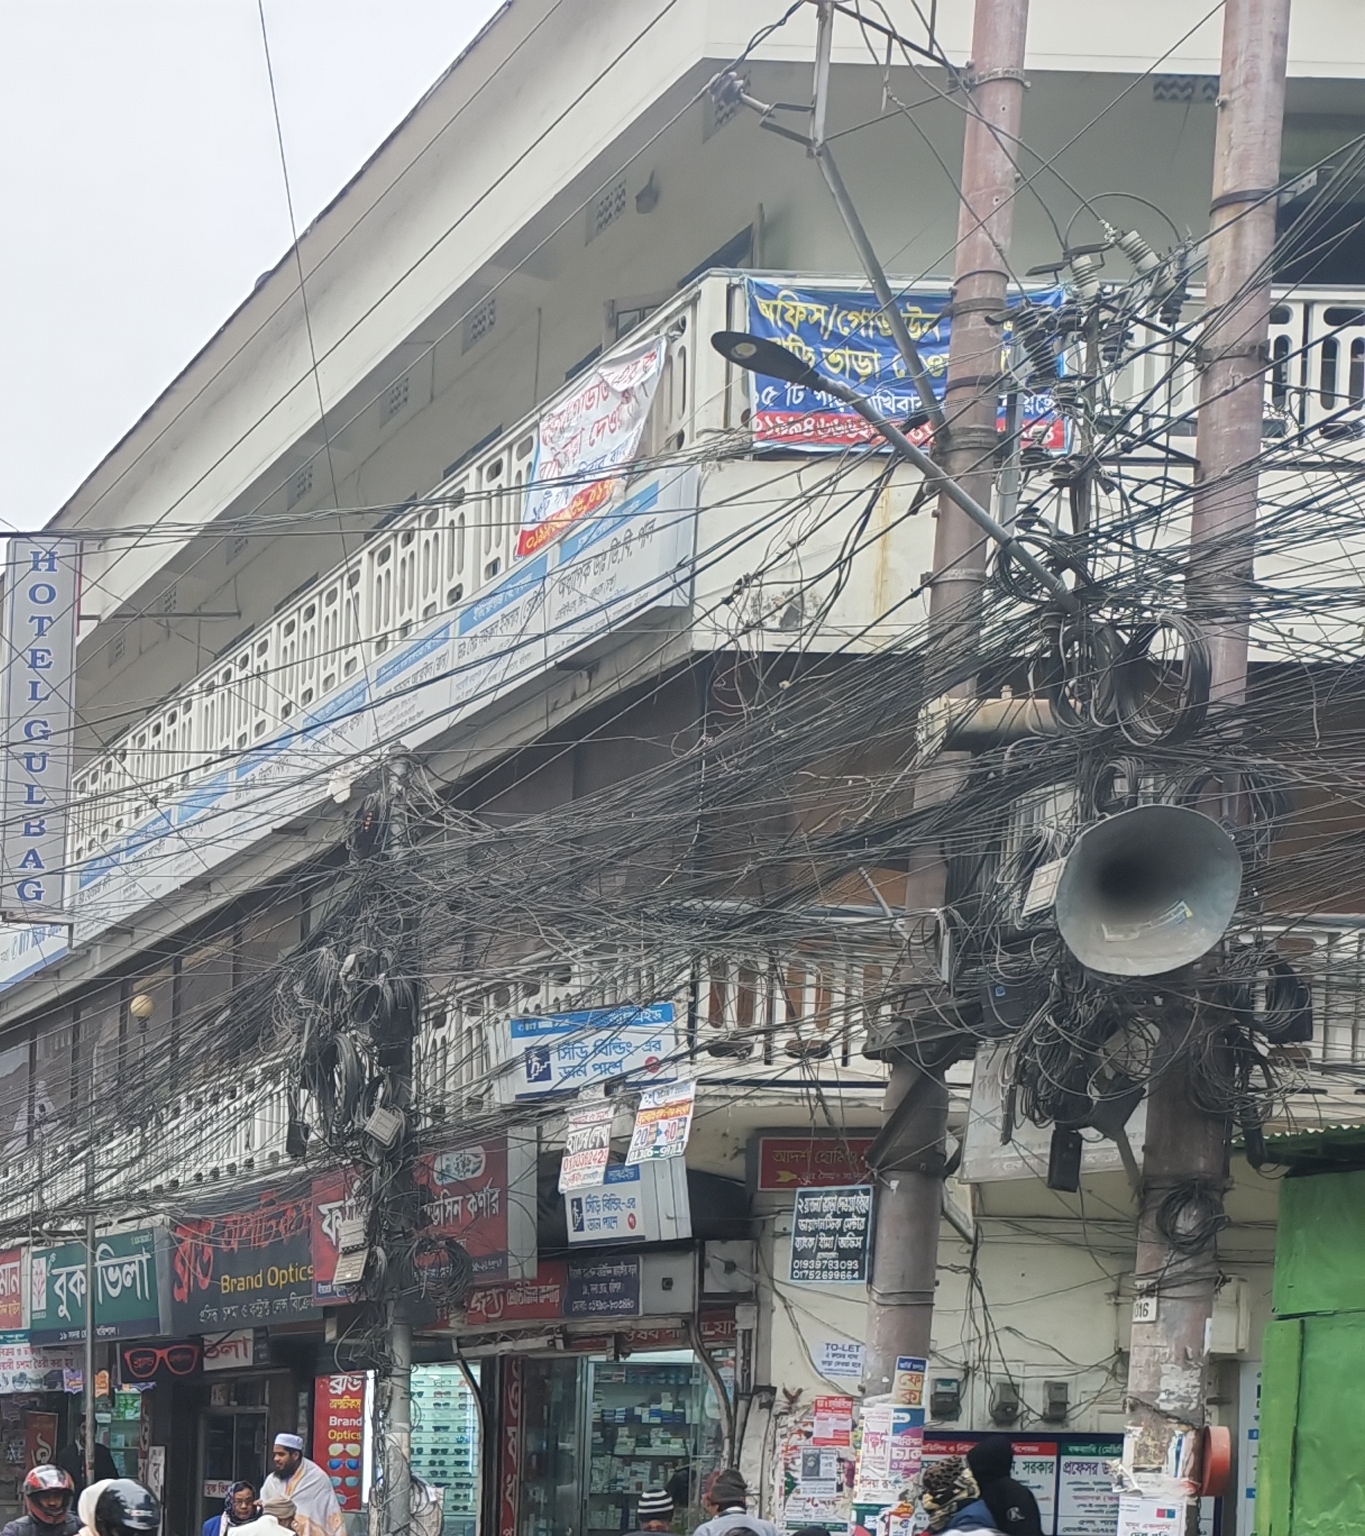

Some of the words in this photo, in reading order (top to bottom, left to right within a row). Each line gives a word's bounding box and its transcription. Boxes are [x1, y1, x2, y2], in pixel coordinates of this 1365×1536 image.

[26, 549, 59, 702] HOTEL
[16, 719, 53, 902] GULBAG
[51, 1264, 87, 1322] বুক
[95, 1243, 152, 1304] ভিলা
[221, 1268, 263, 1294] Brand
[825, 1343, 861, 1353] TO-LET
[329, 1415, 362, 1427] Brand
